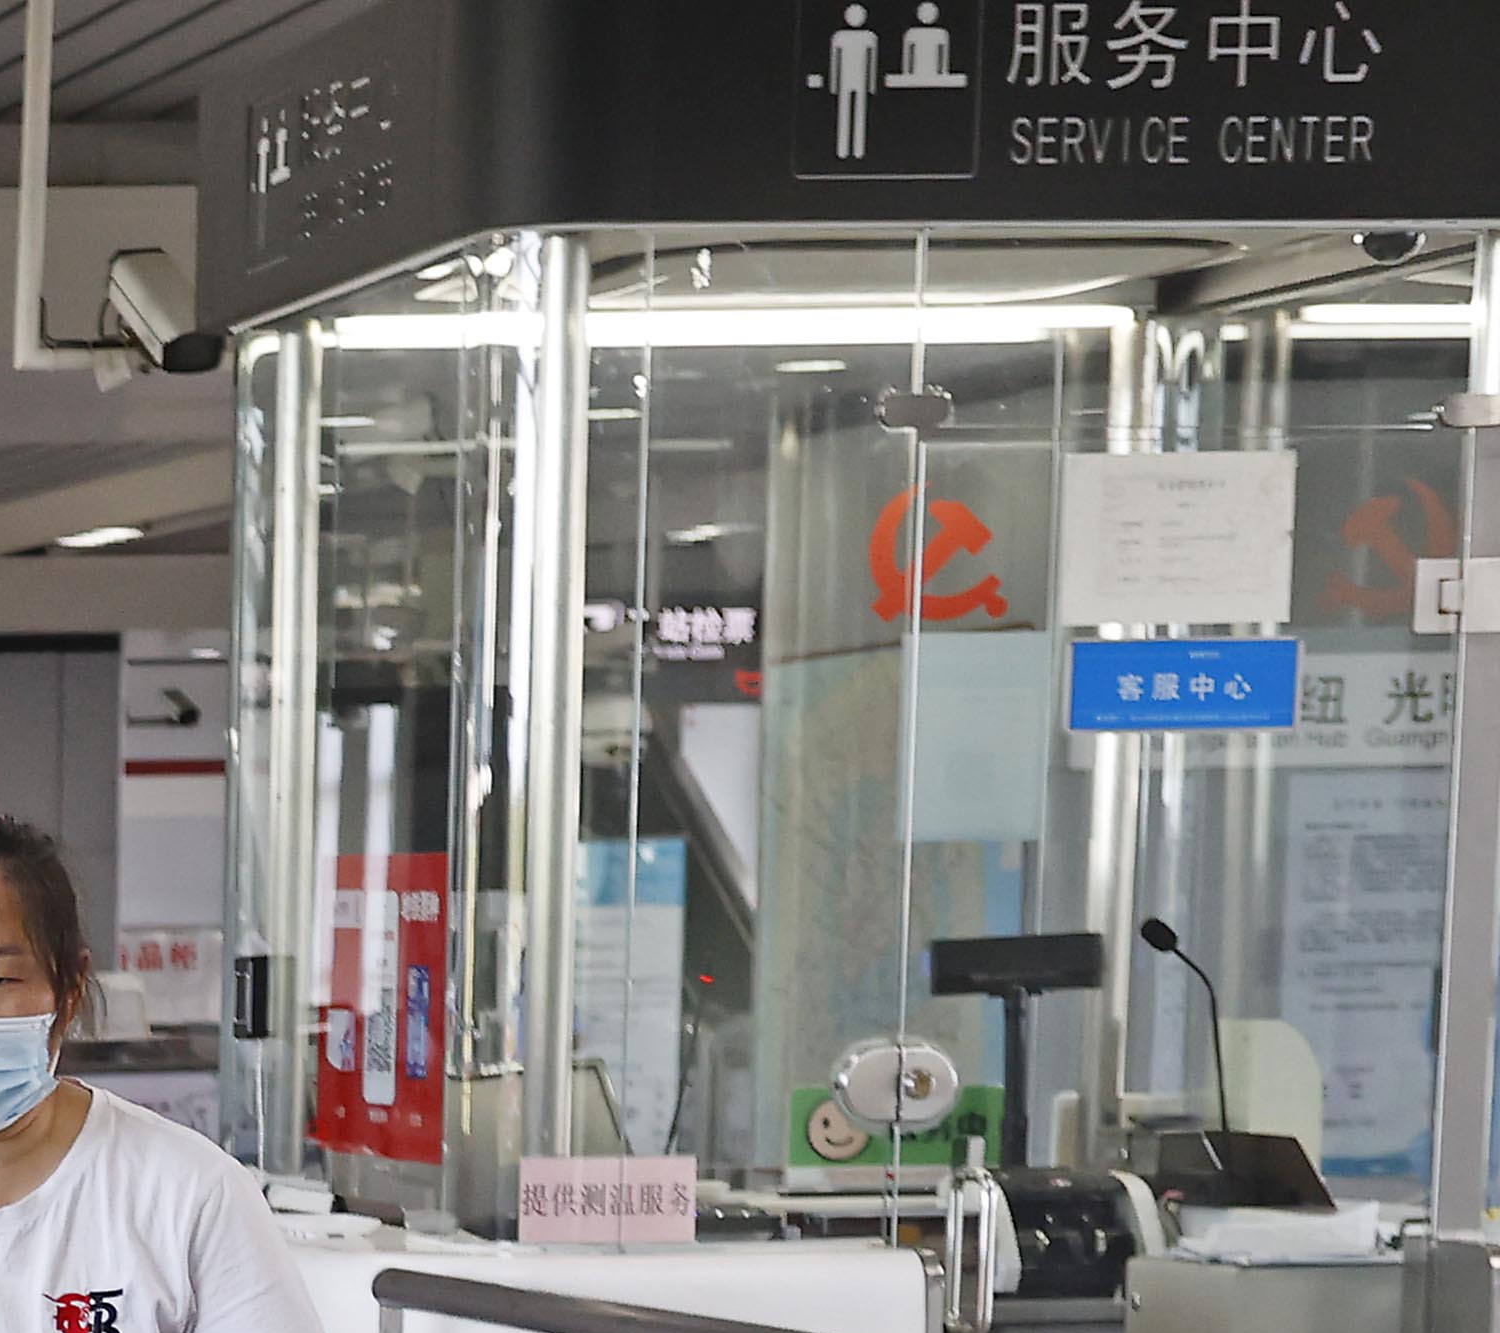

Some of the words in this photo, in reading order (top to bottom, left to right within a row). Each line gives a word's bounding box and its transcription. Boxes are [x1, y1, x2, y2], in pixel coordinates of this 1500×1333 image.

[1007, 0, 1382, 88] 服务中心
[1009, 115, 1191, 165] SERVICE
[1218, 114, 1376, 163] CENTER
[1116, 672, 1253, 702] 客服中心
[521, 1181, 691, 1218] 提供测温服务
